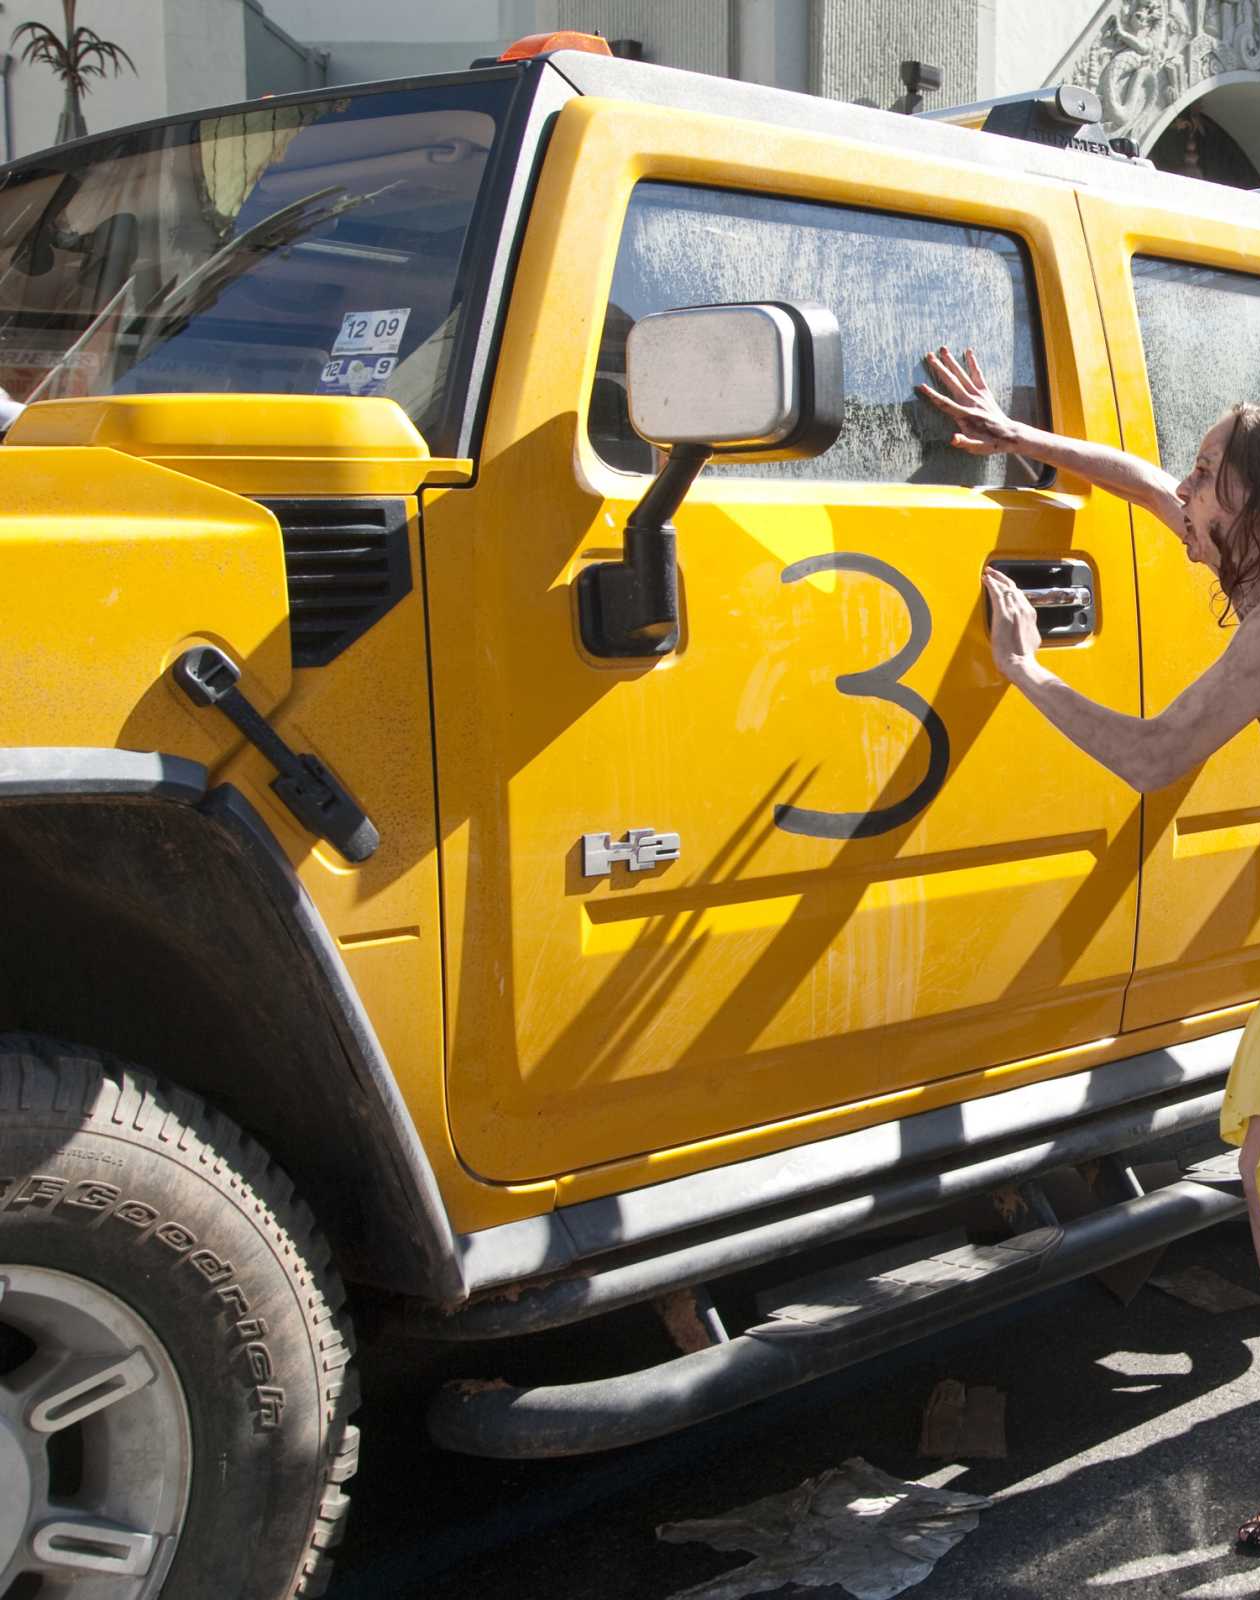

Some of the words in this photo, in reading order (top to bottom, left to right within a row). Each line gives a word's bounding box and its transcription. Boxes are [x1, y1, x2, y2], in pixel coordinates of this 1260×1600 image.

[346, 320, 368, 339] 12
[374, 318, 400, 338] 09
[325, 362, 340, 377] 12
[377, 360, 391, 375] 9
[774, 552, 950, 839] 3
[583, 828, 680, 877] H2
[0, 1173, 286, 1435] FGoodrich
